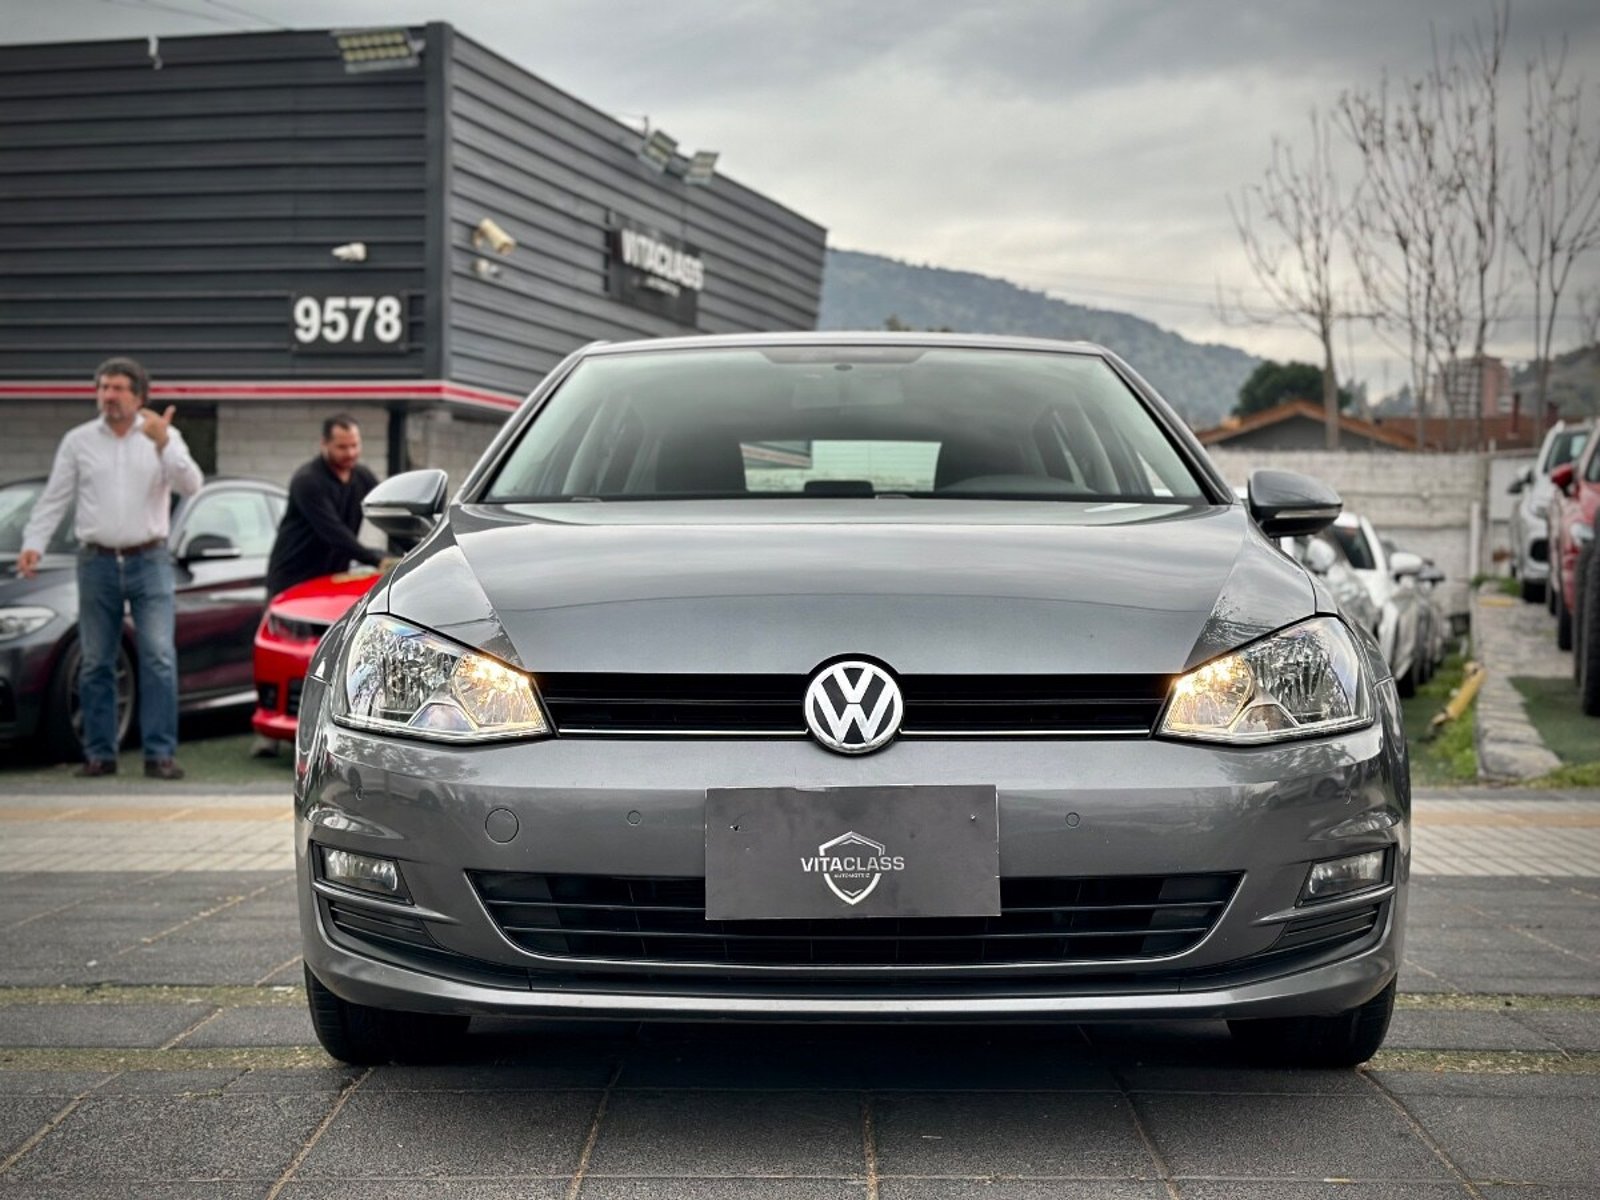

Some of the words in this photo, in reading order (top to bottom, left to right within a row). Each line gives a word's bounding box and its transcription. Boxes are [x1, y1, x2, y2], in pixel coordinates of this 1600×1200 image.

[622, 229, 704, 291] VITACLASS
[293, 296, 402, 342] 9578
[800, 856, 905, 872] VITACLASS
